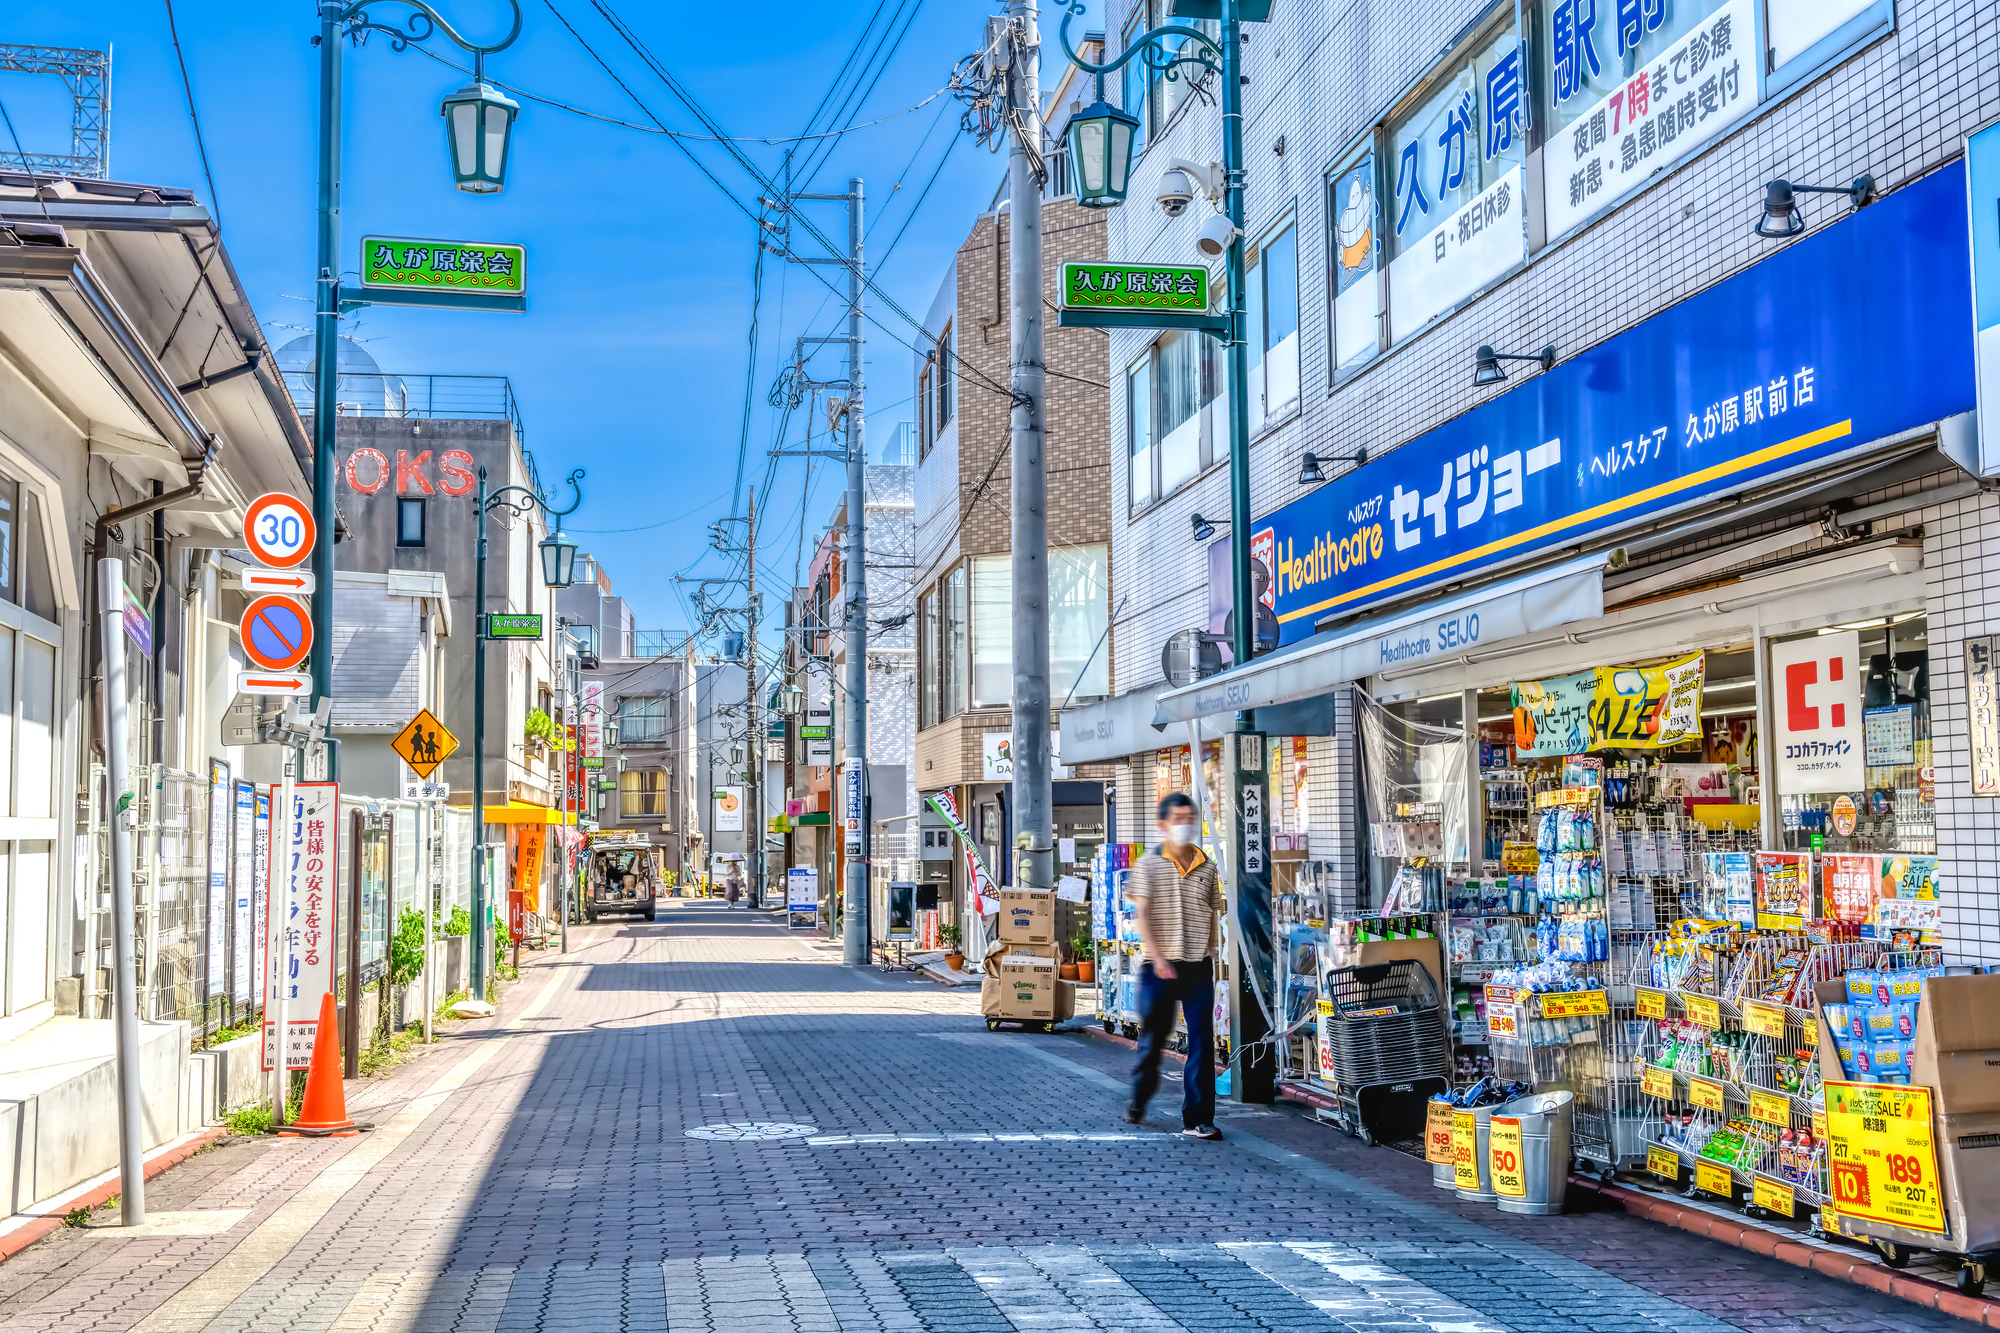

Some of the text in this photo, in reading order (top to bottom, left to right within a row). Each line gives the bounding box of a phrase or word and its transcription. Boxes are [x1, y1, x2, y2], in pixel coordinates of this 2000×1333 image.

[1573, 13, 1732, 162] 夜間7時まで診療
[1569, 59, 1740, 208] 新患・急患随時受付
[1433, 181, 1511, 263] 日・祝日休診
[373, 246, 513, 275] 久が原栄会
[1074, 269, 1198, 295] 久が原栄会
[1591, 366, 1815, 478] ヘルスケア 久が原駅前店
[1277, 437, 1561, 597] Healthcare セイジョー
[1347, 494, 1383, 524] ヘルスケア
[261, 514, 300, 548] 30
[493, 618, 539, 628] 久が原栄会
[1380, 613, 1480, 666] Healthcare SEIJO
[1227, 682, 1250, 706] SEIJO
[1523, 706, 1586, 736] ハッピーサマー
[1587, 696, 1661, 746] SALE
[1970, 643, 1995, 790] セイジョービル
[1525, 739, 1557, 749] HAPPY
[1786, 740, 1850, 758] ココカラファイン
[407, 787, 446, 798] 通学路
[1246, 789, 1259, 869] 久が原栄会
[304, 820, 326, 966] 皆様の安全を守る
[1902, 874, 1930, 888] SALE
[1010, 907, 1034, 917] Kleenex
[1013, 980, 1037, 990] Kleenex
[1877, 1101, 1901, 1117] SALE
[1455, 1120, 1470, 1129] SALE
[1863, 1117, 1887, 1133] 除湿剤
[1432, 1131, 1450, 1146] 198
[1834, 1143, 1848, 1158] 217
[1456, 1146, 1472, 1163] 269
[1458, 1167, 1473, 1178] 295
[1500, 1175, 1518, 1186] 825
[1885, 1153, 1922, 1185] 189
[1838, 1171, 1858, 1199] 10
[1905, 1186, 1926, 1202] 207
